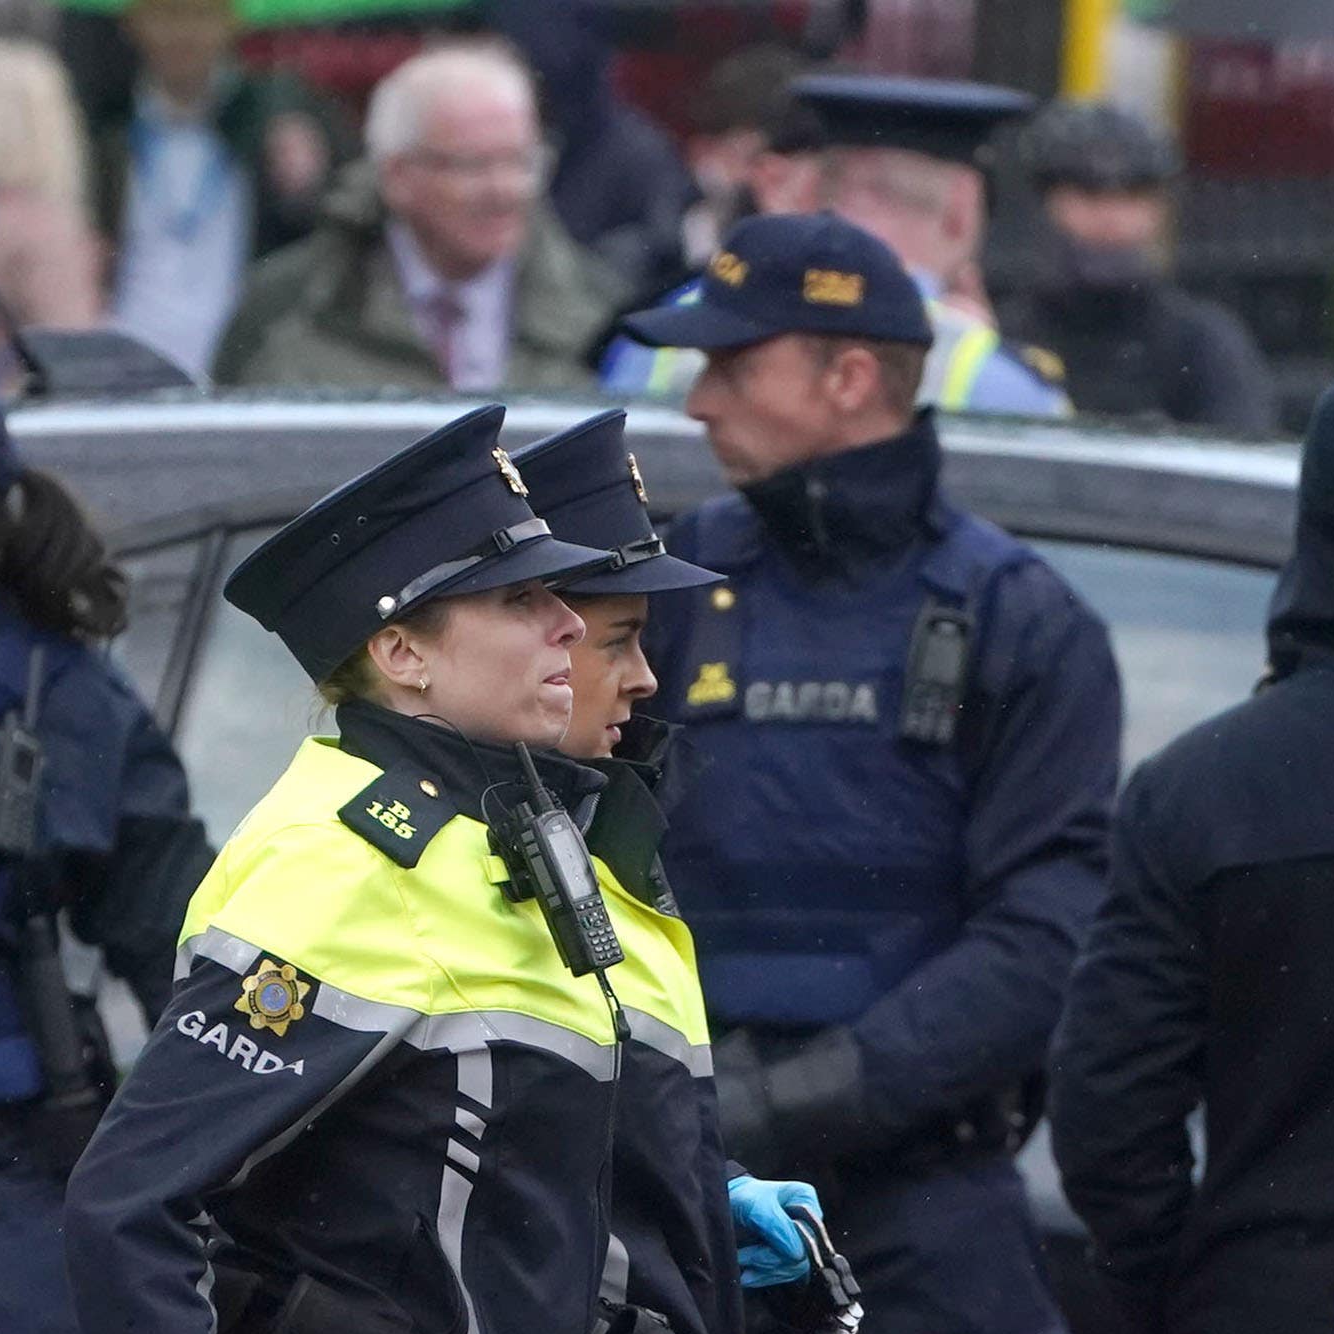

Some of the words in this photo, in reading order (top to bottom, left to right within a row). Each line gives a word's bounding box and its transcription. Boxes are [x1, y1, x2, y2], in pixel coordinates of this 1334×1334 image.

[744, 681, 877, 722] GARDA
[365, 801, 418, 840] 185
[387, 799, 411, 820] B
[176, 1010, 305, 1076] GARDA
